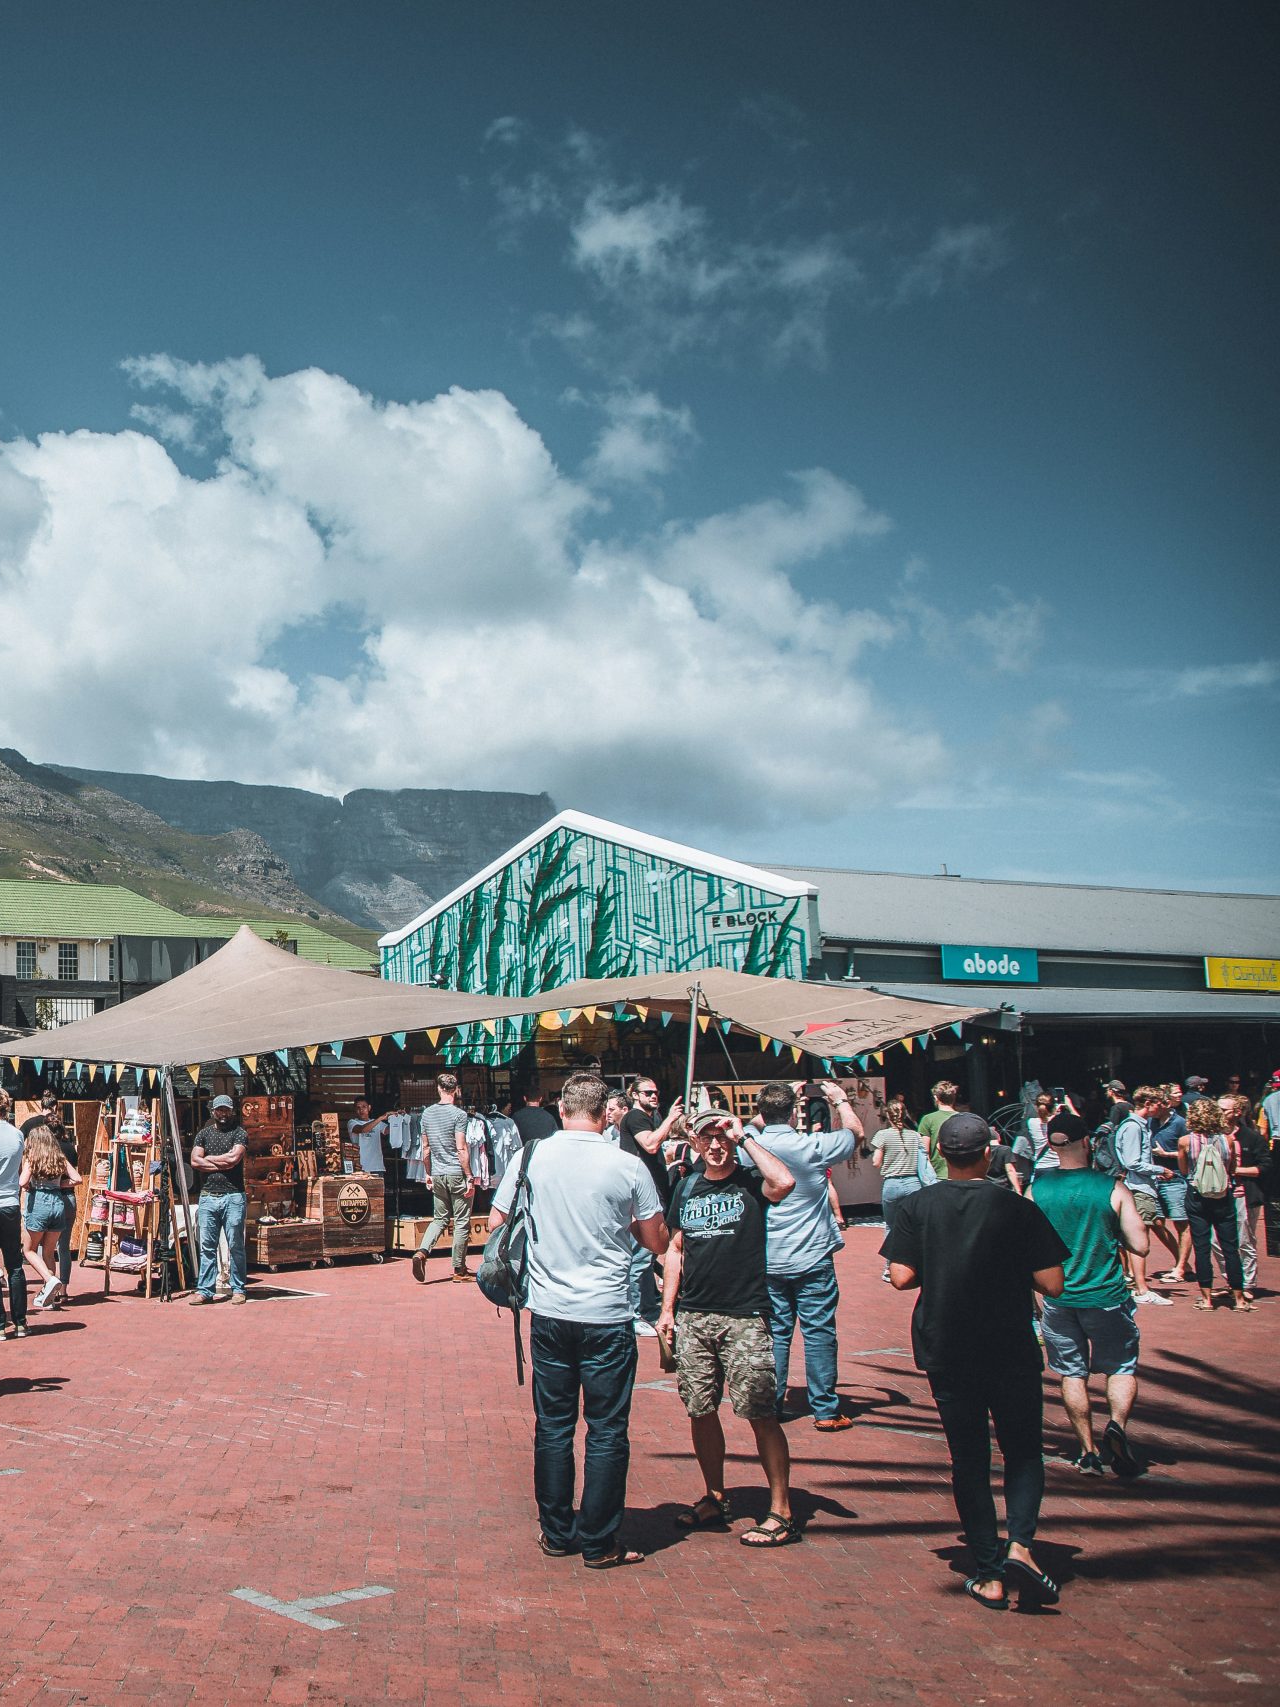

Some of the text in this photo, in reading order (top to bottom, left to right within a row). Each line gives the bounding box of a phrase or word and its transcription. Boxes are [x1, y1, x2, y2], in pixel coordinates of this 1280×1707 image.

[712, 910, 778, 928] E BLOCK
[963, 952, 1020, 975] abode
[704, 1214, 741, 1230] Brand
